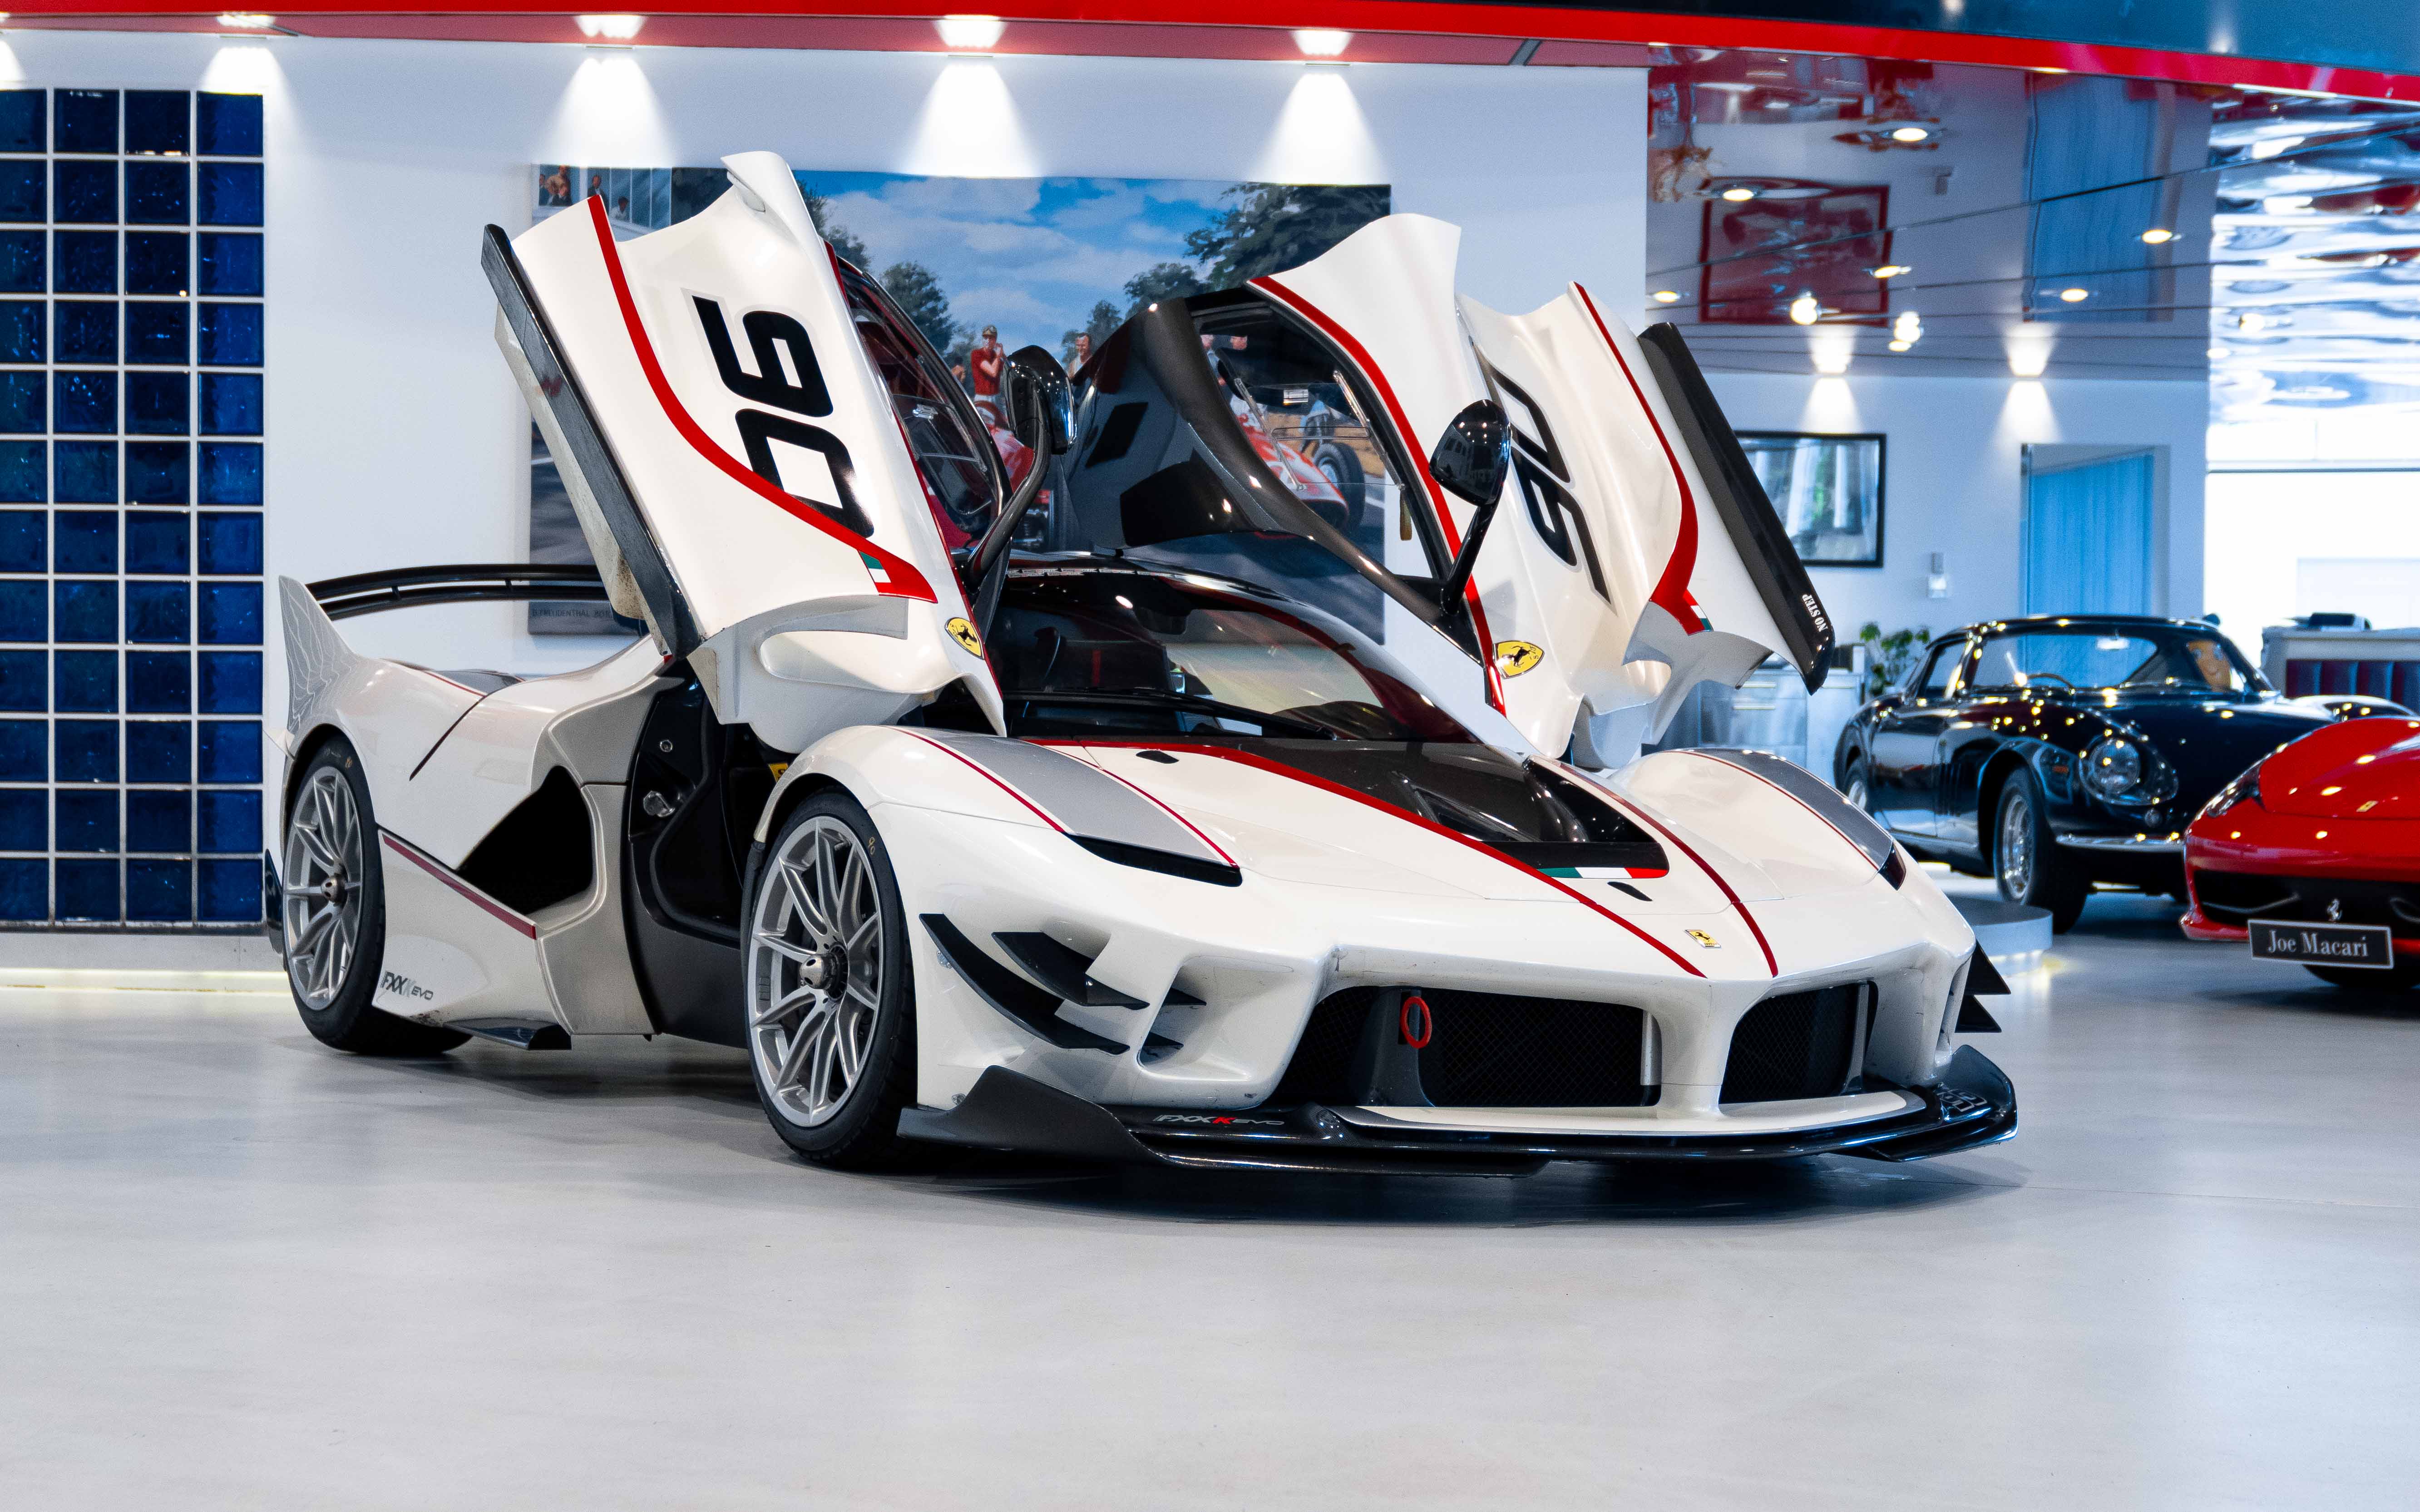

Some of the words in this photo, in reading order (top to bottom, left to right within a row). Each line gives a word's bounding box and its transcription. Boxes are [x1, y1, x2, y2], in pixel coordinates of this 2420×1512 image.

[1802, 594, 1821, 617] STEP
[1814, 616, 1828, 632] NO
[2268, 929, 2297, 953] Joe
[2301, 931, 2368, 957] Macari
